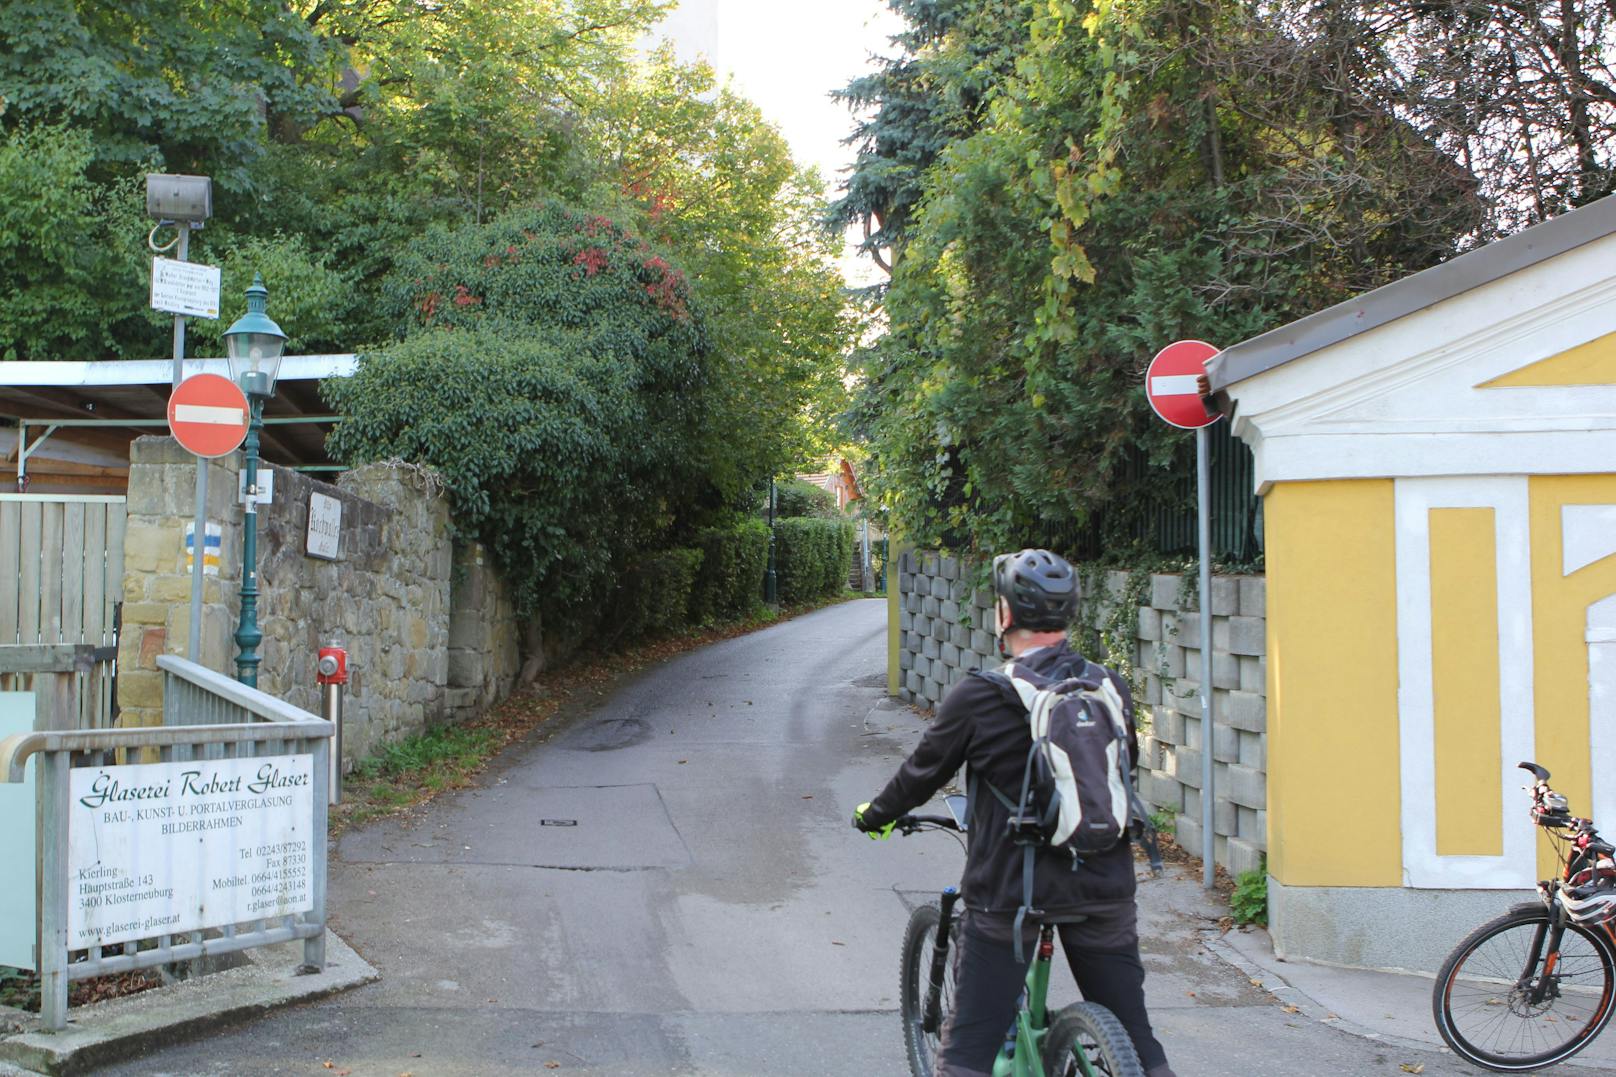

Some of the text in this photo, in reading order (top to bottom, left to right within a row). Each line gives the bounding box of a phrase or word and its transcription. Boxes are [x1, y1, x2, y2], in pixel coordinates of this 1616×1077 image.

[80, 763, 308, 808] Glaserei Robert Glaser
[104, 796, 292, 823] BAU-, KUNST- U. PORTALVERGLASUNG
[161, 816, 243, 835] BILDERRAHMEN
[256, 841, 306, 857] 02243/87292
[266, 855, 305, 869] Fax 87330
[79, 874, 153, 895] Hauptstraße 143
[251, 867, 306, 884] 0664/4155552
[79, 887, 173, 909] 3400 Klosterneuburg
[79, 913, 180, 938] www.glaserei-glaser.at
